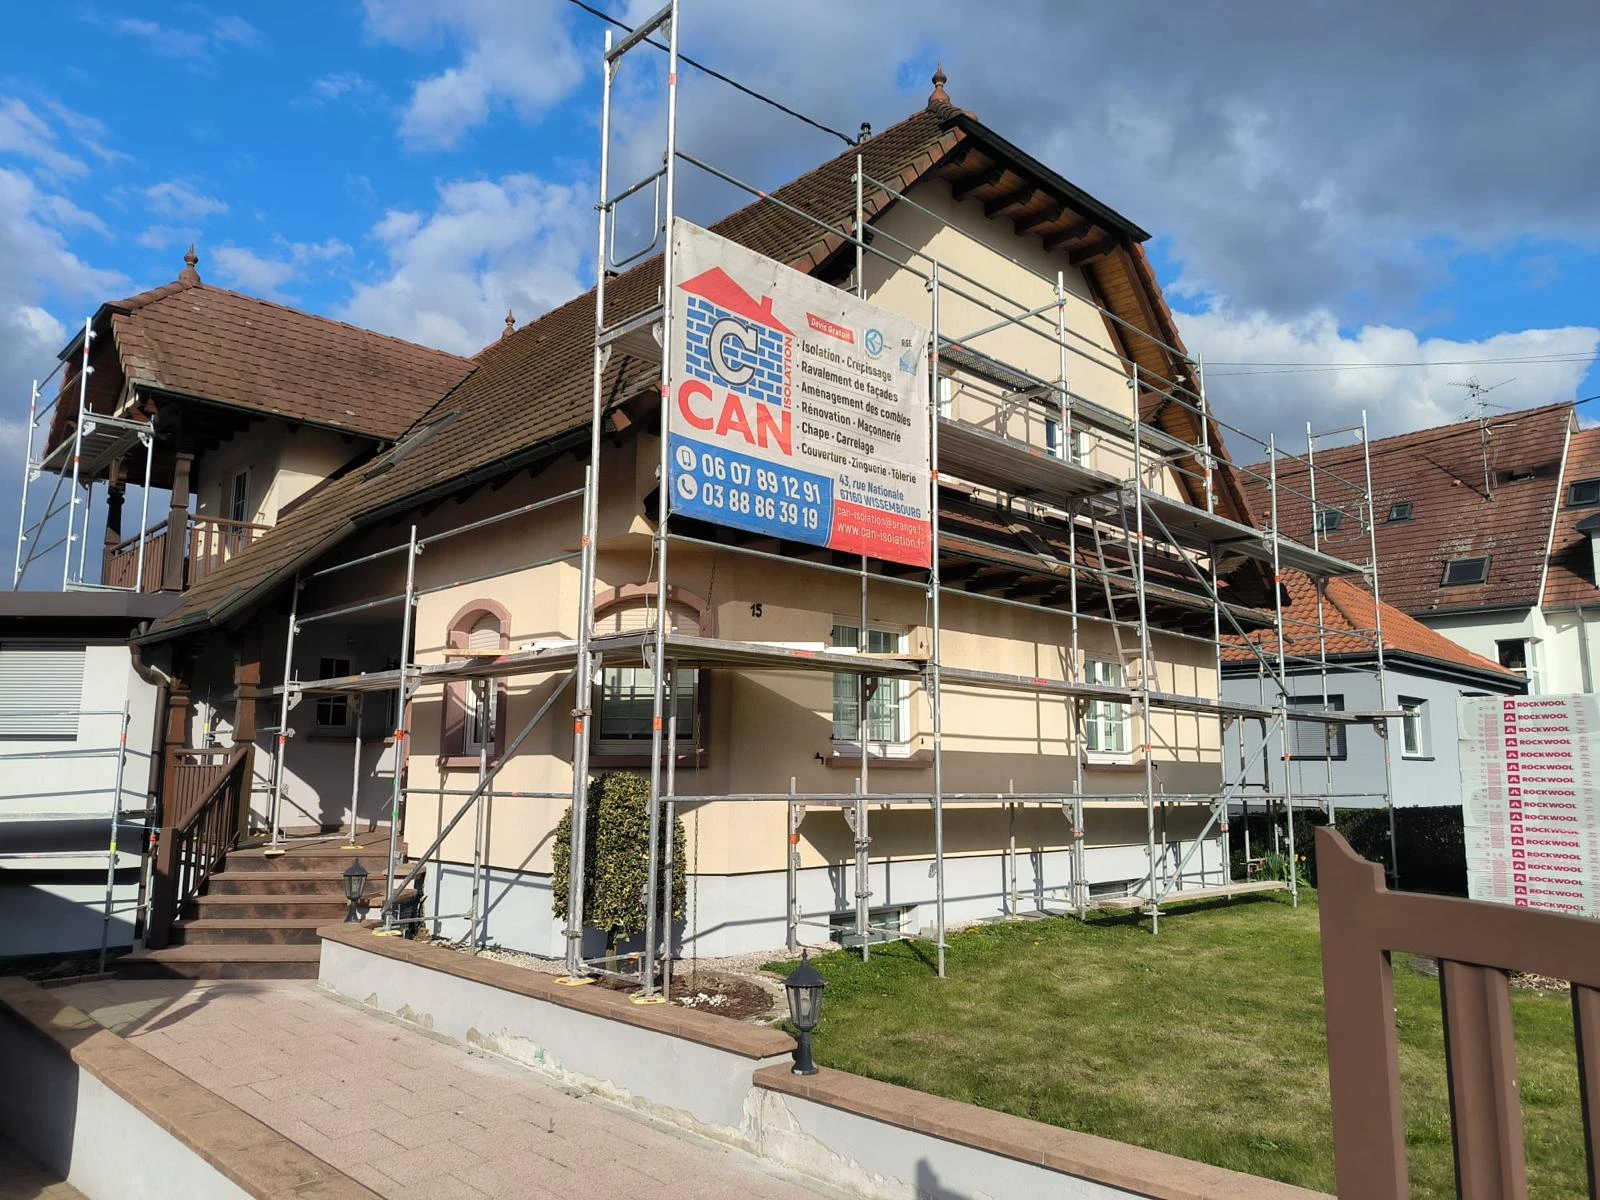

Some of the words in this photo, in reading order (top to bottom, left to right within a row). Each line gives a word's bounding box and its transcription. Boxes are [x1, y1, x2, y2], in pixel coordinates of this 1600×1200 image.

[811, 318, 828, 332] Devis
[802, 340, 840, 363] Isolation
[783, 336, 793, 409] ISOLATION
[801, 360, 852, 388] Ravalement
[854, 379, 865, 392] de
[866, 382, 898, 402] façades
[678, 379, 792, 456] CAN
[801, 382, 864, 410] Aménagement
[865, 401, 879, 416] des
[880, 409, 911, 427] combles
[801, 401, 851, 426] Rénovation
[857, 418, 901, 443] Maçonnerie
[801, 421, 830, 440] Chape
[836, 431, 875, 455] Carrelage
[801, 442, 847, 465] Couverture
[851, 457, 887, 476] Zinguerie
[891, 468, 917, 484] Tôlerie
[701, 453, 726, 481] 06
[730, 461, 750, 486] 07
[756, 468, 778, 494] 89
[782, 475, 800, 499] 12
[803, 480, 821, 505] 91
[839, 474, 851, 490] 43,
[852, 480, 866, 491] rue
[868, 482, 904, 501] Nationale
[702, 482, 724, 508] 03
[729, 489, 750, 514] 88
[755, 495, 775, 520] 86
[779, 501, 798, 525] 39
[802, 506, 818, 530] 19
[839, 489, 862, 504] 67160
[864, 495, 921, 519] WISSEMBOURG
[837, 522, 925, 550] www.can-isolation.fr
[750, 603, 762, 617] 15
[1528, 852, 1581, 860] ROCKWOOL
[1528, 864, 1582, 872] ROCKWOOL
[1529, 877, 1584, 885] ROCKWOOL
[1530, 889, 1584, 898] ROCKWOOL
